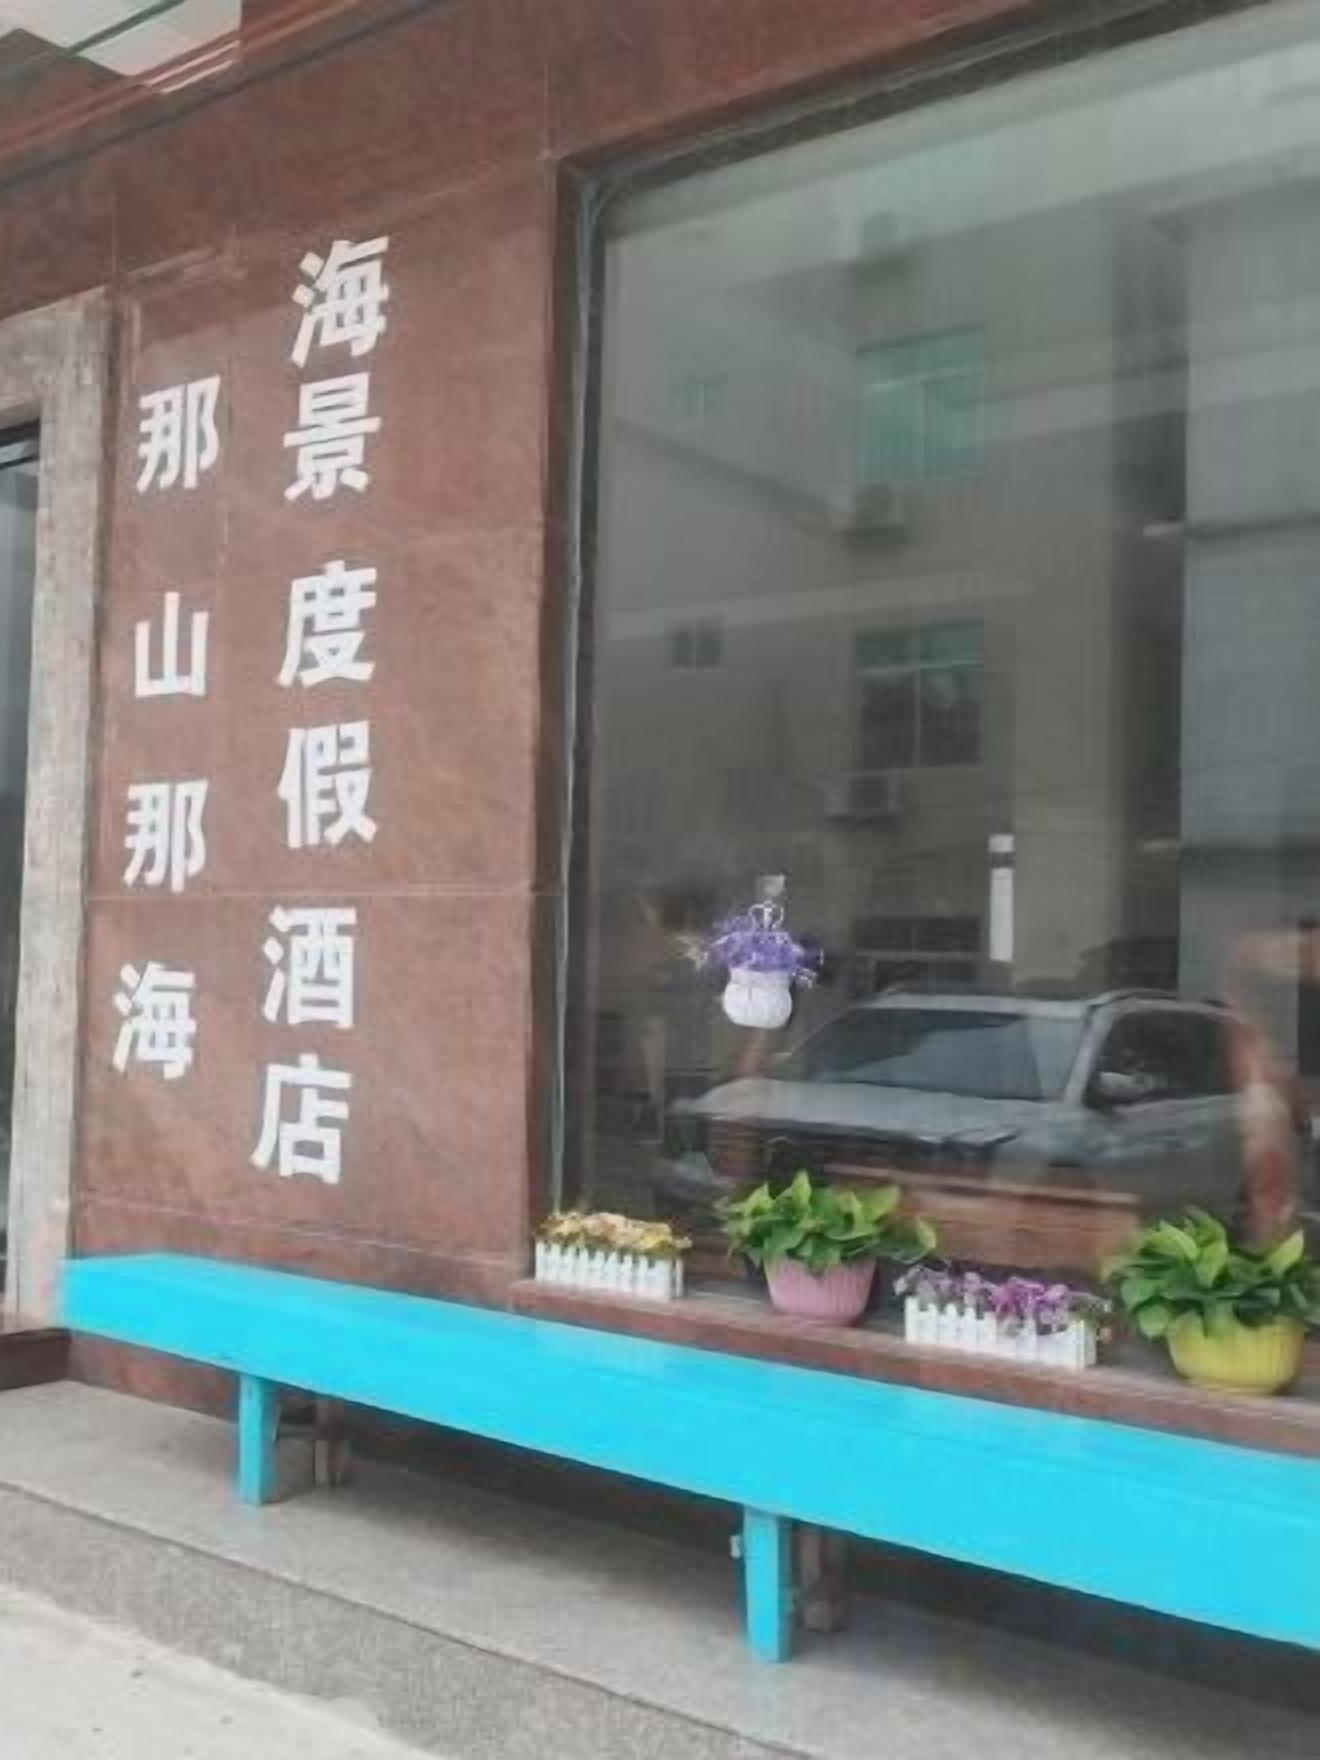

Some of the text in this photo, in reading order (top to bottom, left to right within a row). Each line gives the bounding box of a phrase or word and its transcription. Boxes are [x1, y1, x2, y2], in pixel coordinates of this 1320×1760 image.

[111, 375, 221, 1081] 那山那海
[250, 237, 390, 1185] 海景度假酒店
